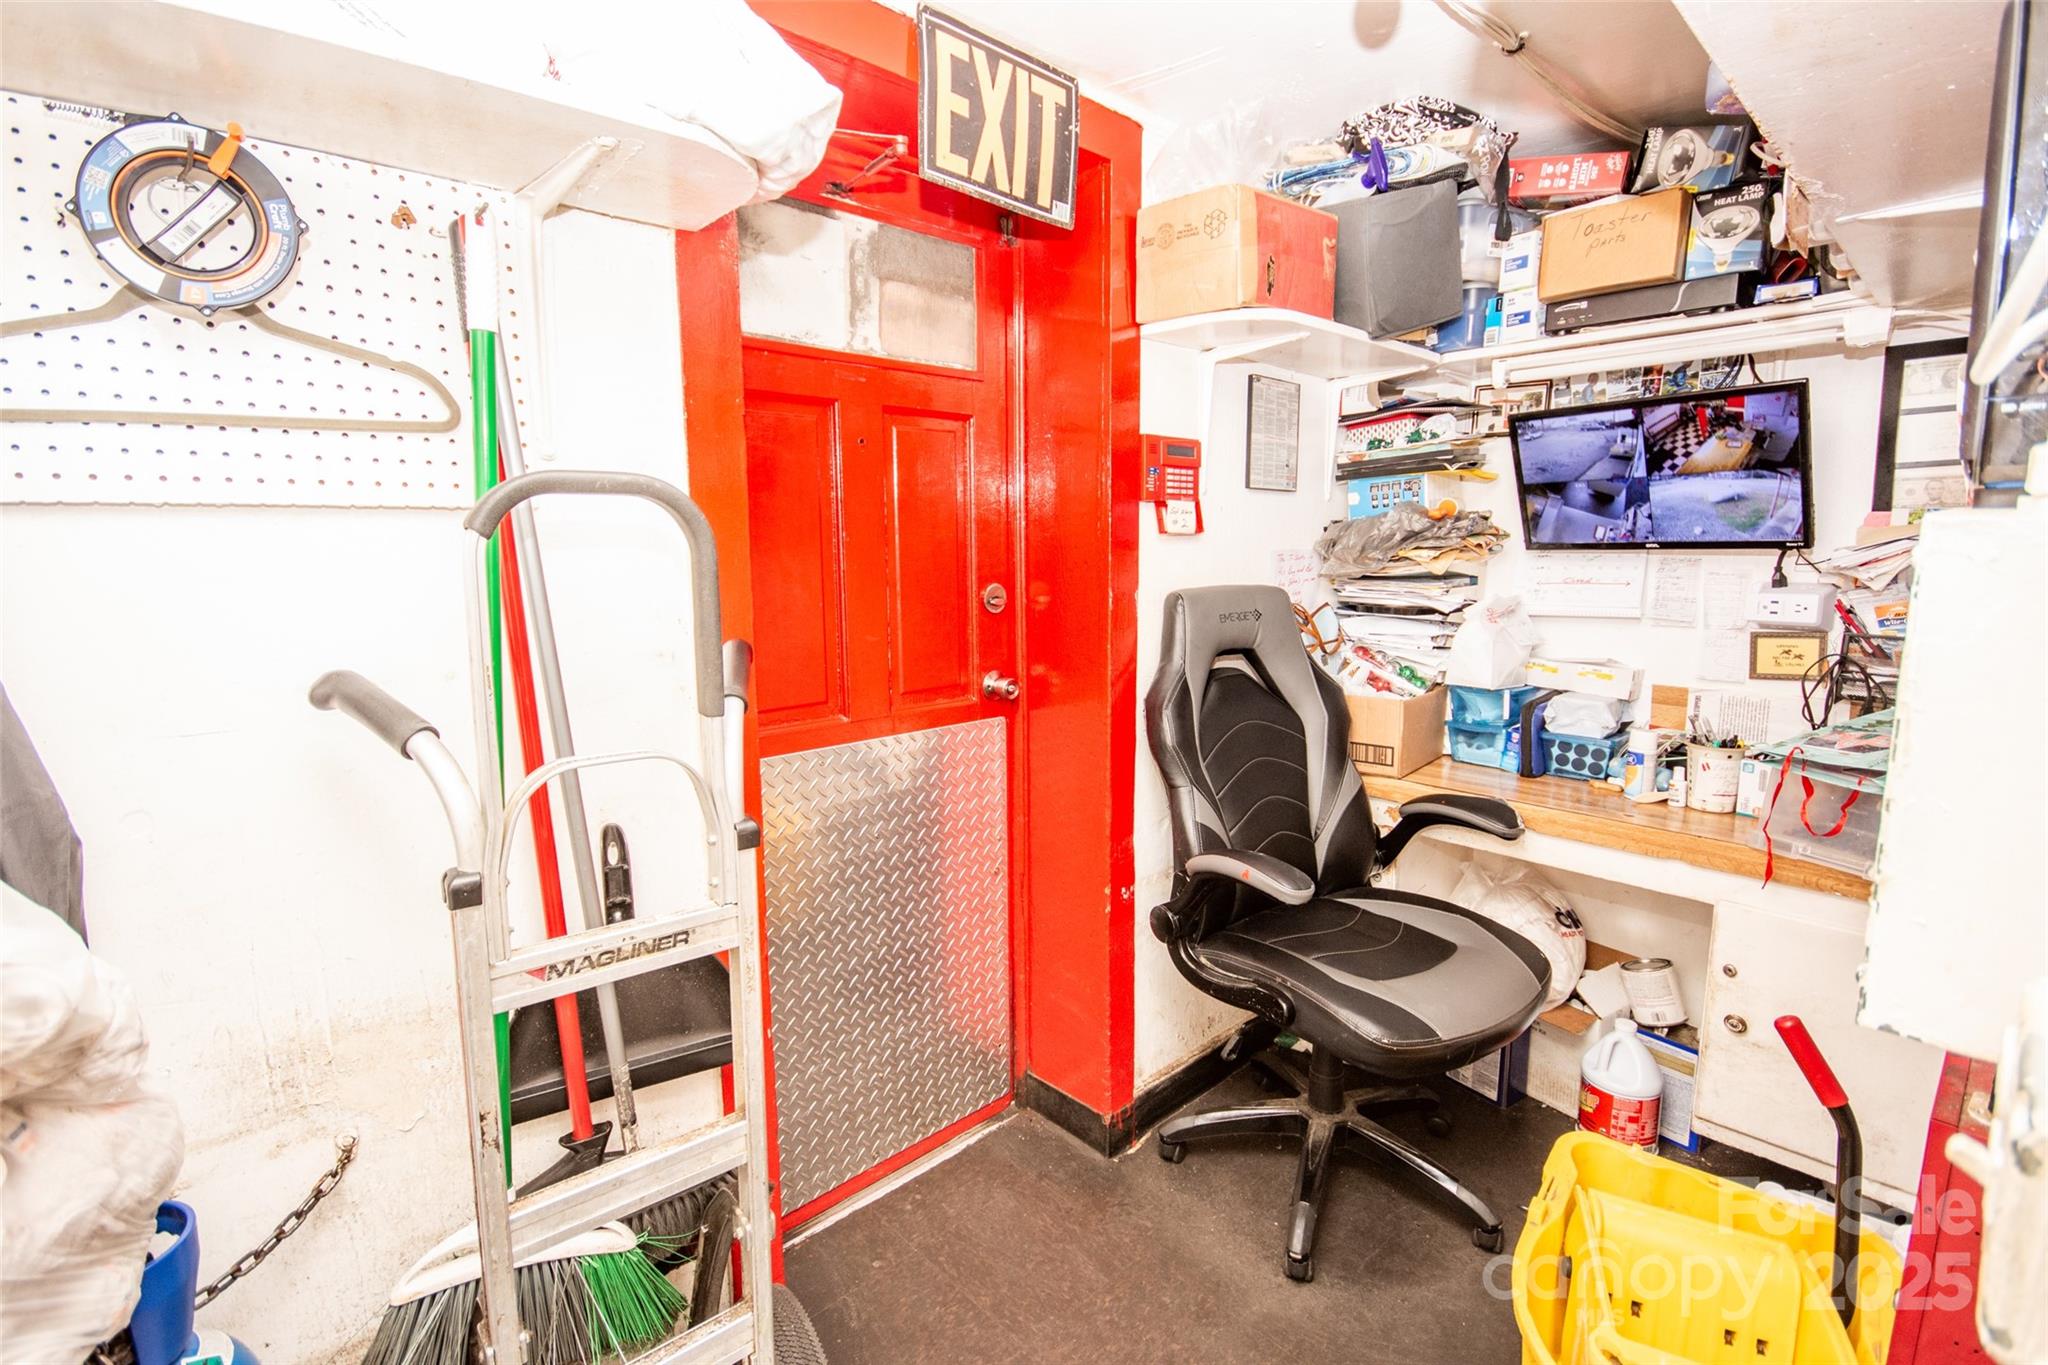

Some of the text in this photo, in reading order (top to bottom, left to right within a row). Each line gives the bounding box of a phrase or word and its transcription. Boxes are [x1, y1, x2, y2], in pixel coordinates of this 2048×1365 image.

[936, 29, 1067, 210] EXIT
[1714, 195, 1737, 206] HEAT
[1738, 191, 1764, 202] LAMP
[268, 204, 281, 230] Craft
[278, 204, 290, 231] Plumb
[1570, 206, 1651, 240] Toaster
[1585, 233, 1626, 258] parts
[547, 930, 690, 981] MAGLINER
